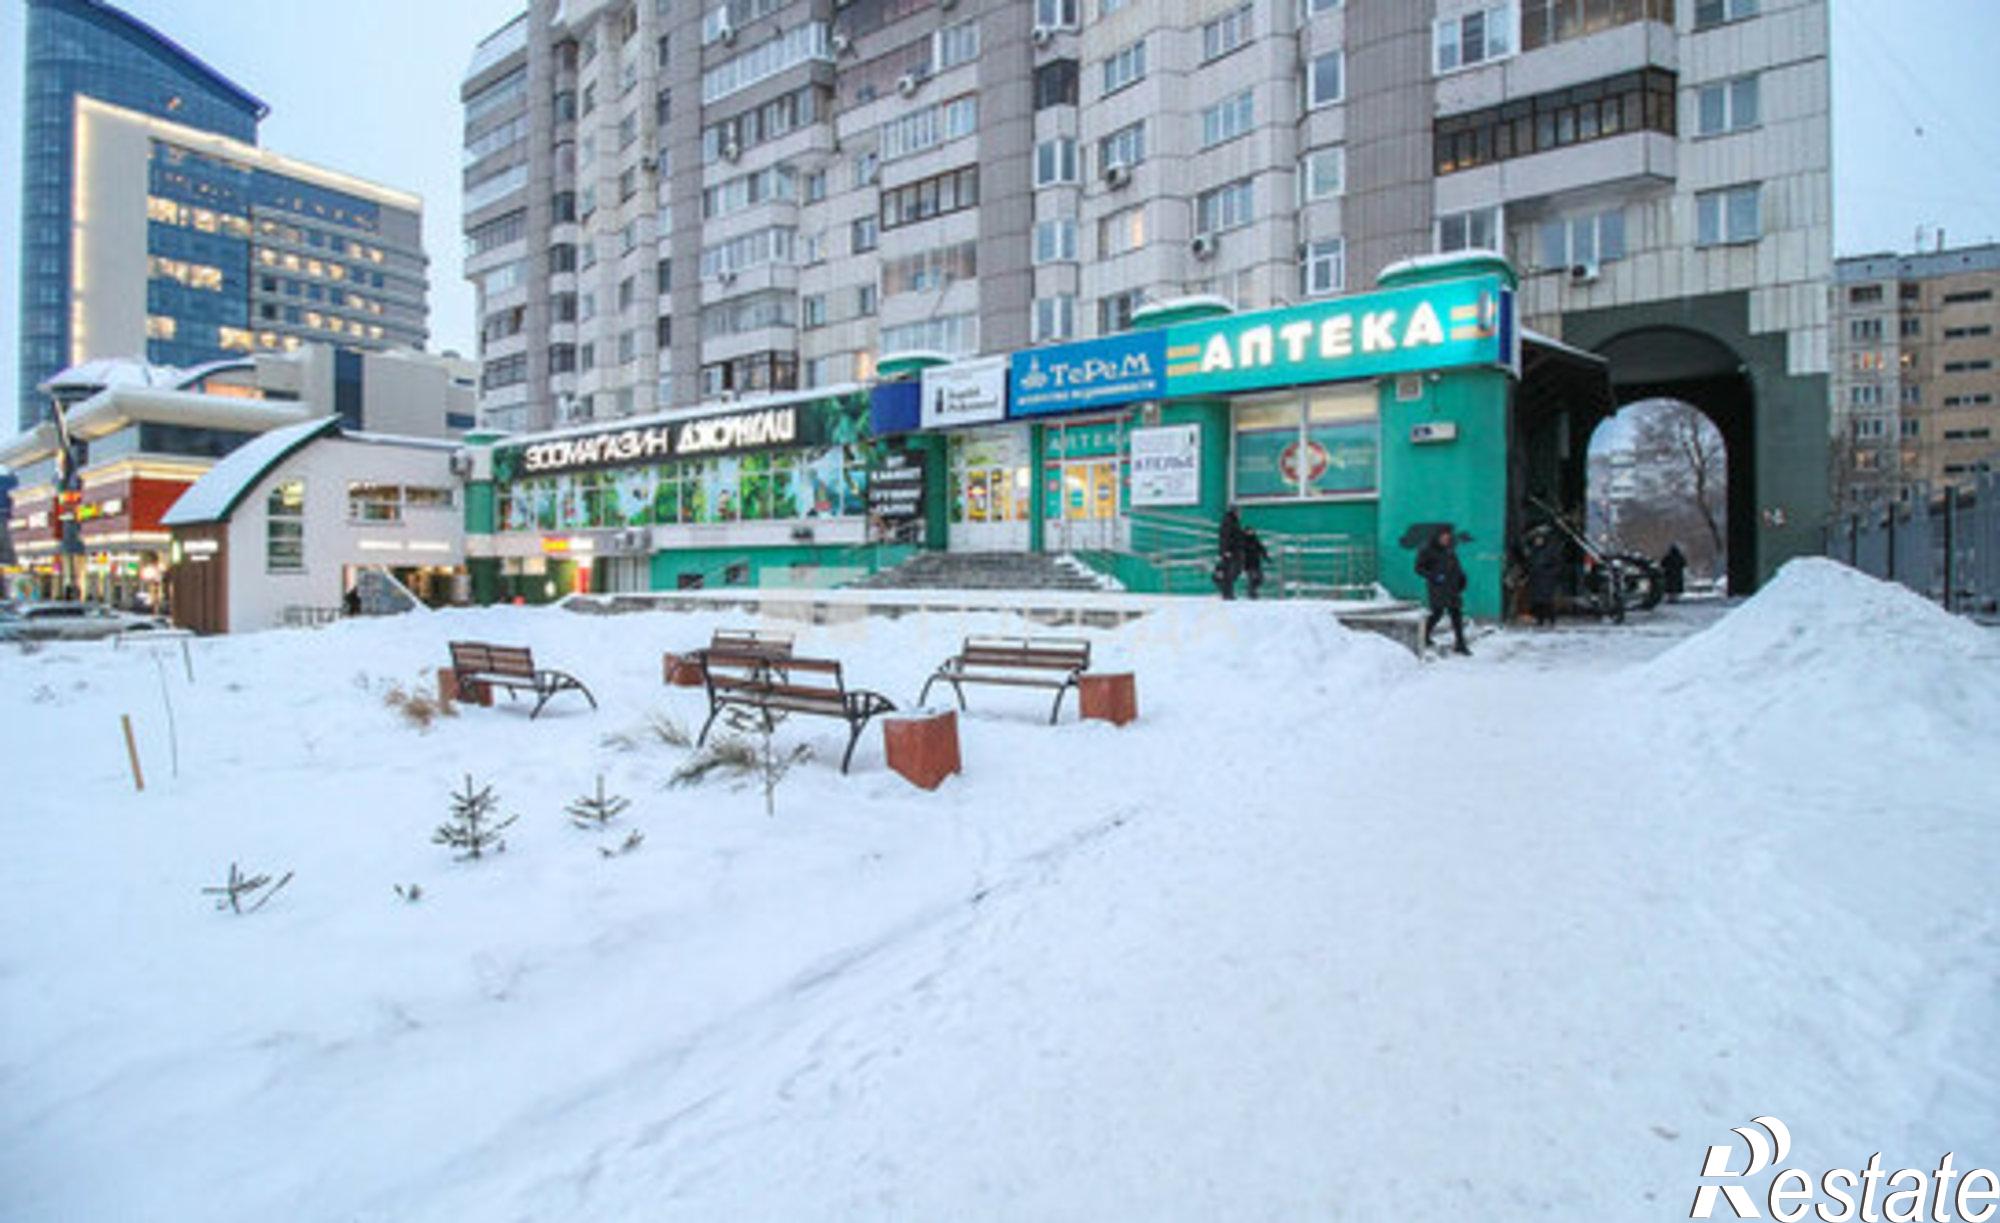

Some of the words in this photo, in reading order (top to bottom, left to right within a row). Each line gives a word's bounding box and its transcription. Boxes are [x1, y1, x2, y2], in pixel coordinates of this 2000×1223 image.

[1200, 301, 1445, 373] АПТЕКА
[525, 430, 668, 471] ЗООМАГАЗИН
[677, 408, 795, 454] ДЖУНГЛИ
